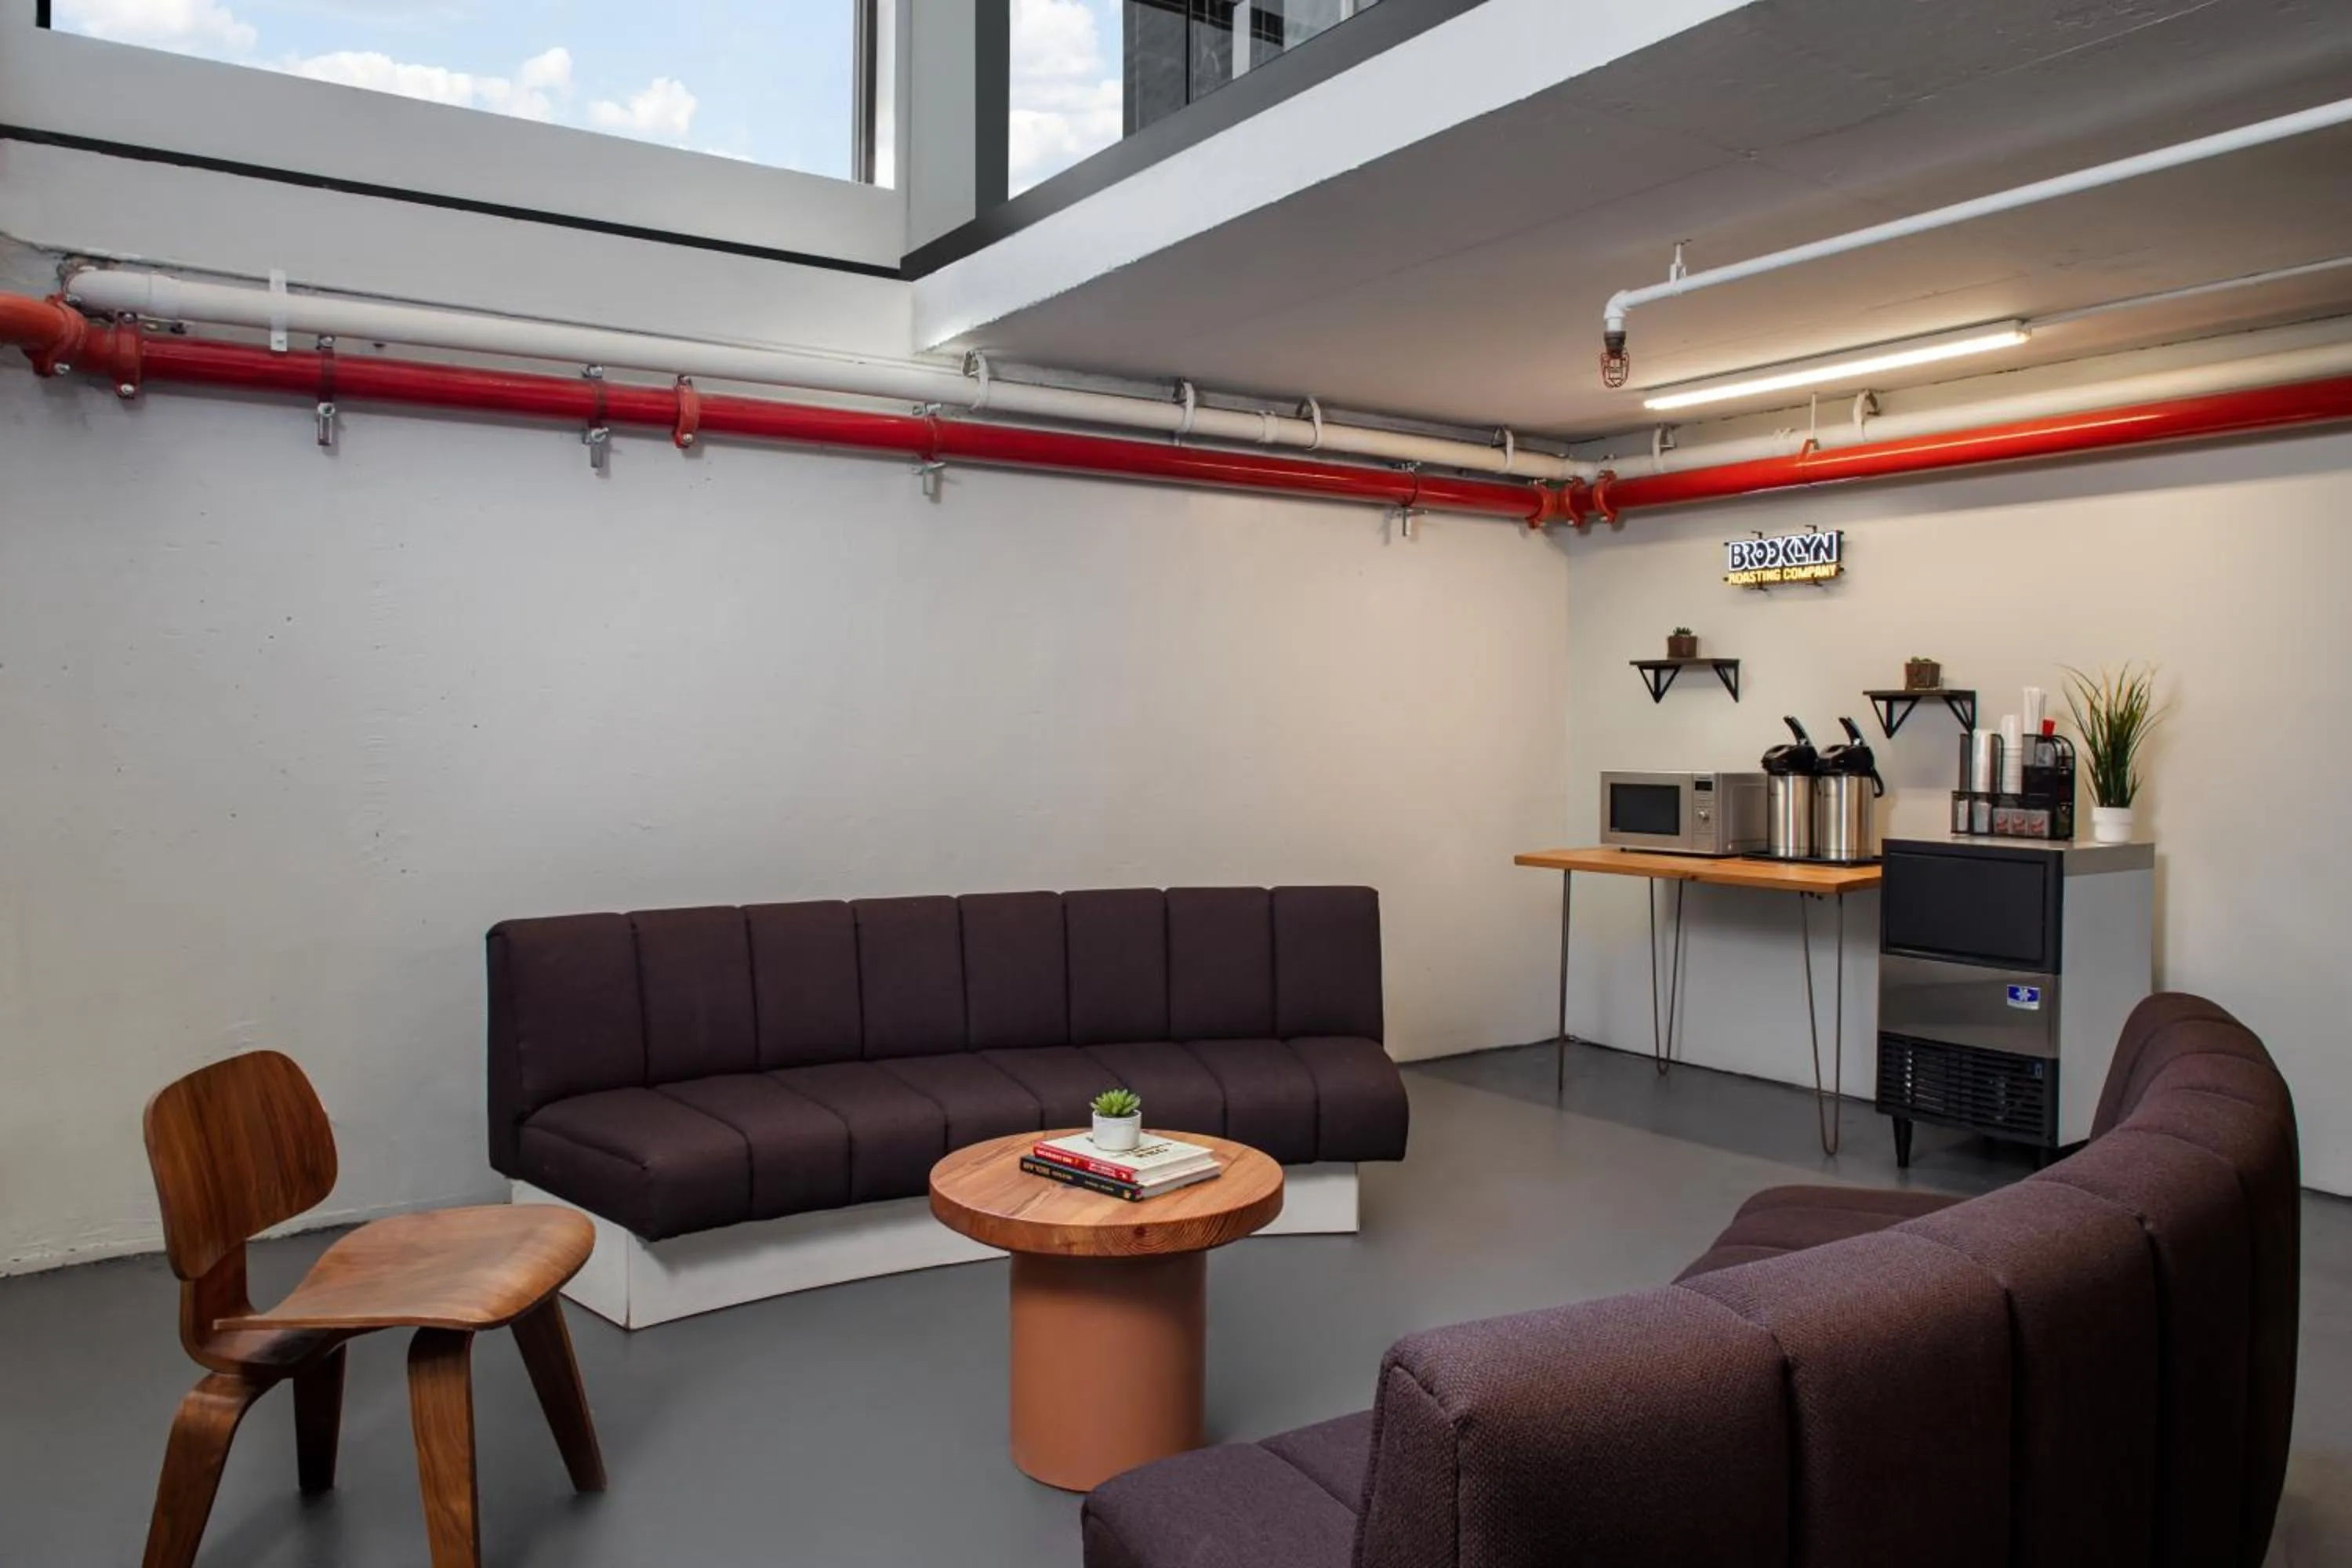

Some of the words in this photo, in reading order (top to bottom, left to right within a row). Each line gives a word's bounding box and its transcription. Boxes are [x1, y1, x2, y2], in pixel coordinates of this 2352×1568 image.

[1730, 532, 1837, 571] BROOKLYN
[1729, 568, 1781, 584] ROASTING
[1783, 564, 1837, 580] COMPANY
